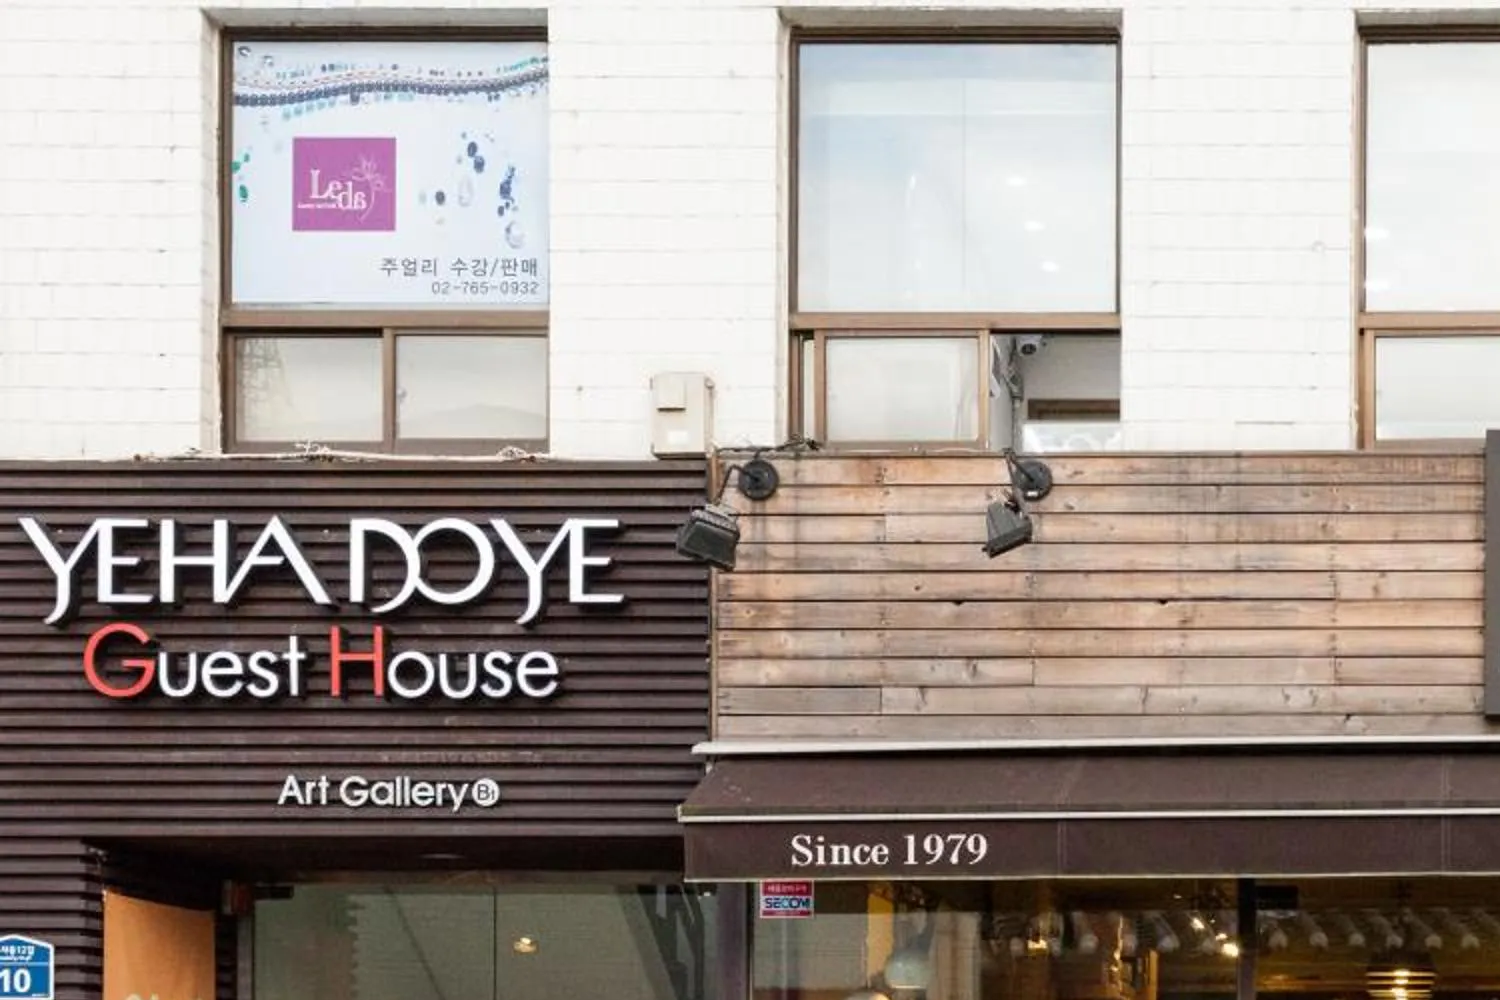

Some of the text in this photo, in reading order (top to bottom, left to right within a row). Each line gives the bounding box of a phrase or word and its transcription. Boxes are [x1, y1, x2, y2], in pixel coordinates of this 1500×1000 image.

[380, 257, 538, 277] 주얼리 수강/판매
[431, 281, 539, 295] 02-765-0932
[19, 515, 625, 624] YEHA DOYE
[83, 623, 560, 698] Guest House
[277, 774, 331, 806] Art
[339, 775, 469, 813] Gallery
[790, 833, 988, 867] Since 1979
[764, 897, 811, 909] SECOM
[0, 967, 32, 993] 10
